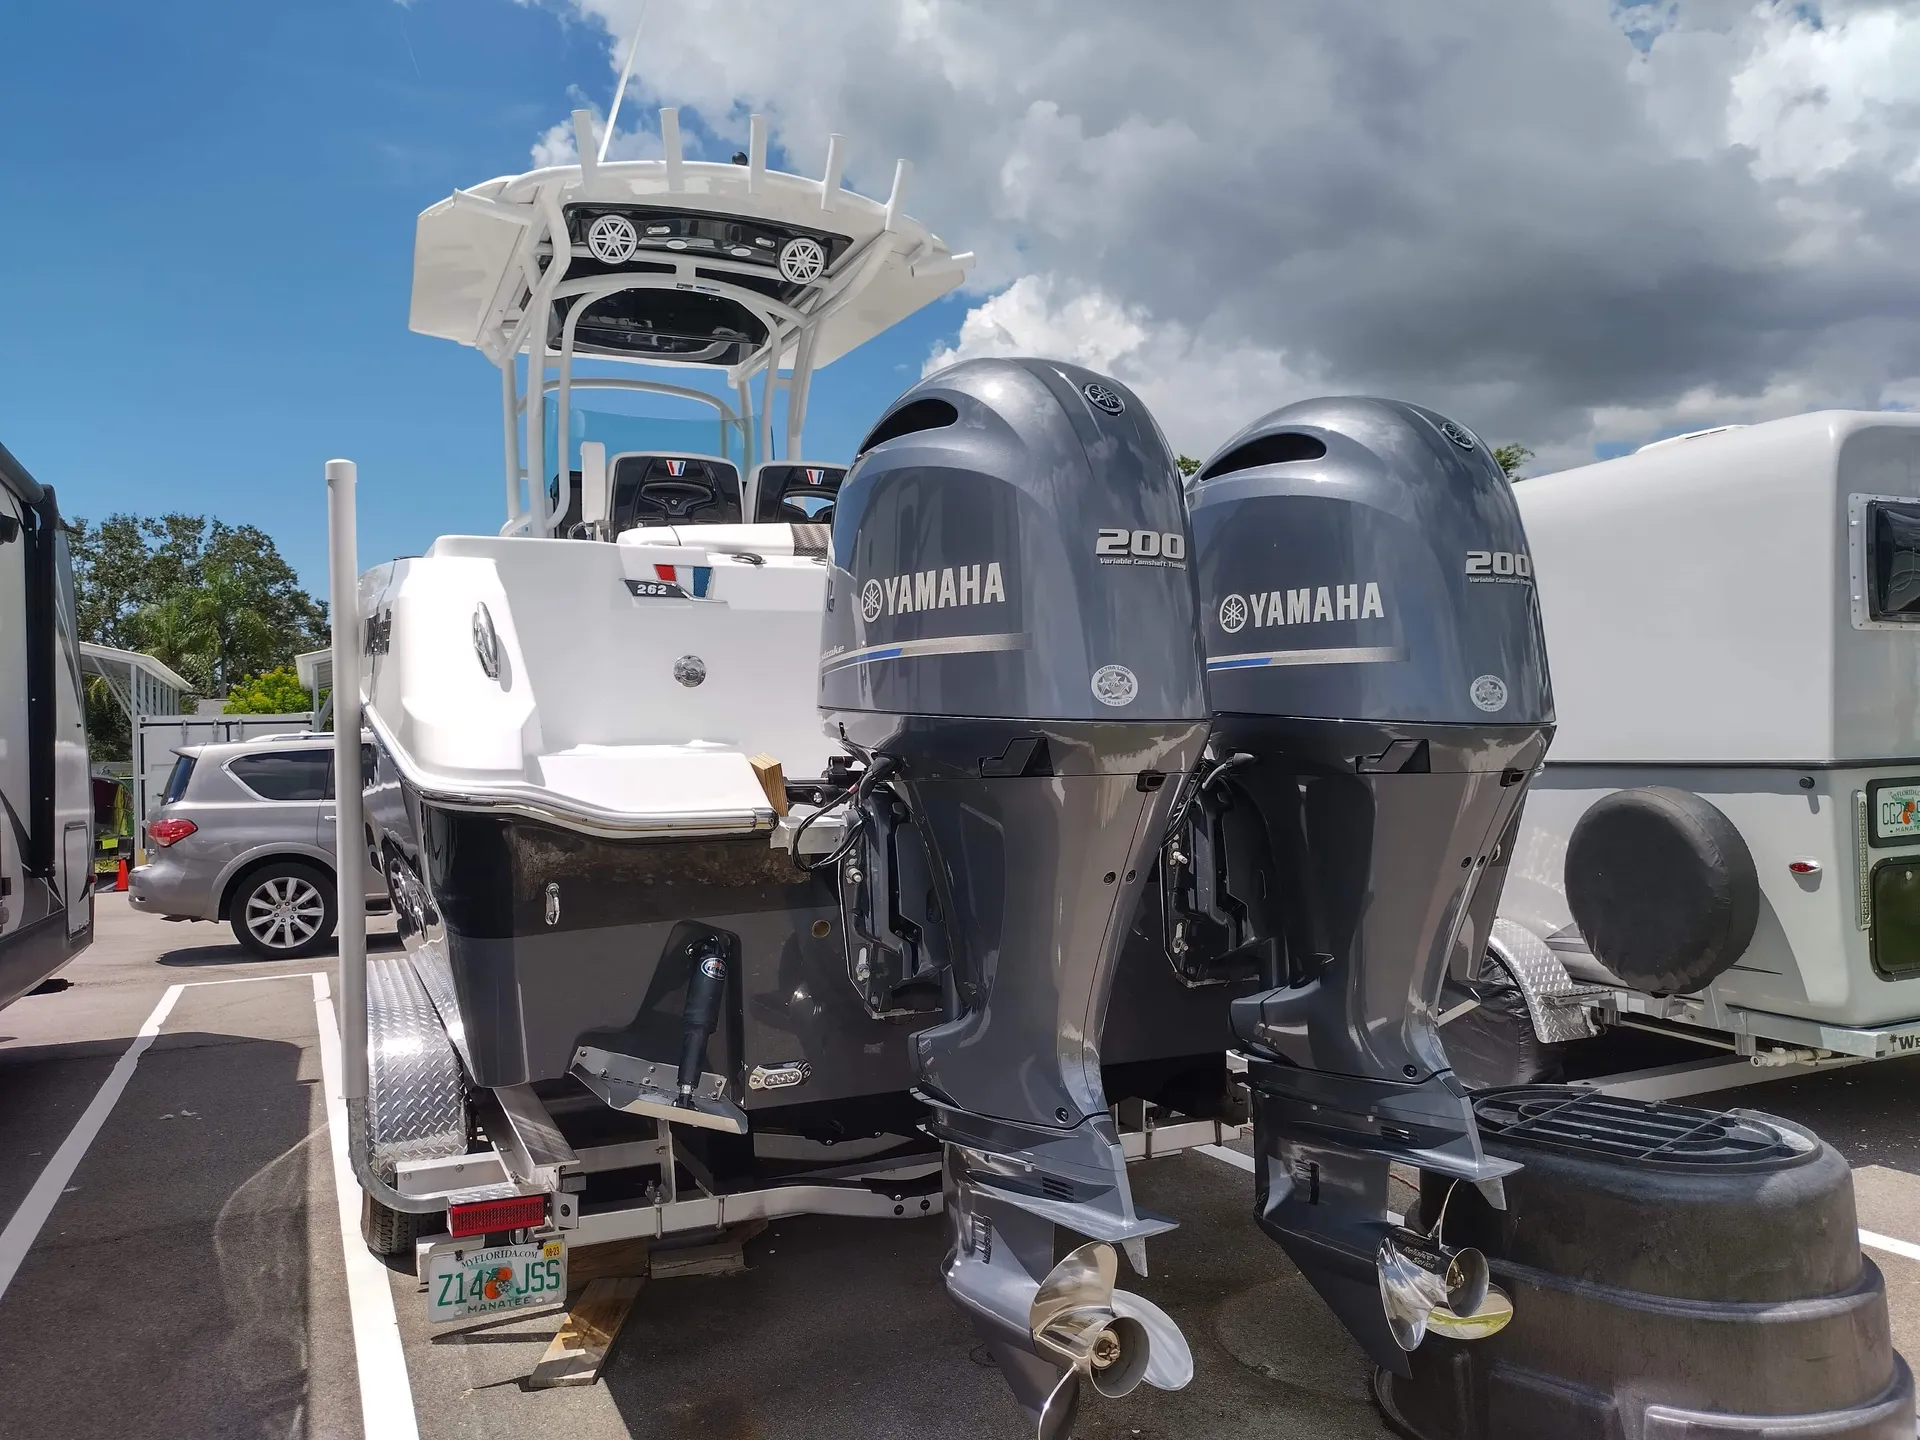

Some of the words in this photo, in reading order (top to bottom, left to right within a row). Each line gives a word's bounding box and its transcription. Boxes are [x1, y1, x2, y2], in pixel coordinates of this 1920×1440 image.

[1095, 528, 1185, 559] 200
[1100, 557, 1132, 565] Variable
[1465, 550, 1531, 577] 200
[637, 584, 667, 595] 262
[884, 562, 1006, 616] YAMAHA
[1250, 582, 1384, 628] YAMAHA
[437, 1269, 483, 1307] Z14
[516, 1259, 560, 1295] JSS
[467, 1296, 531, 1314] MANATEE
